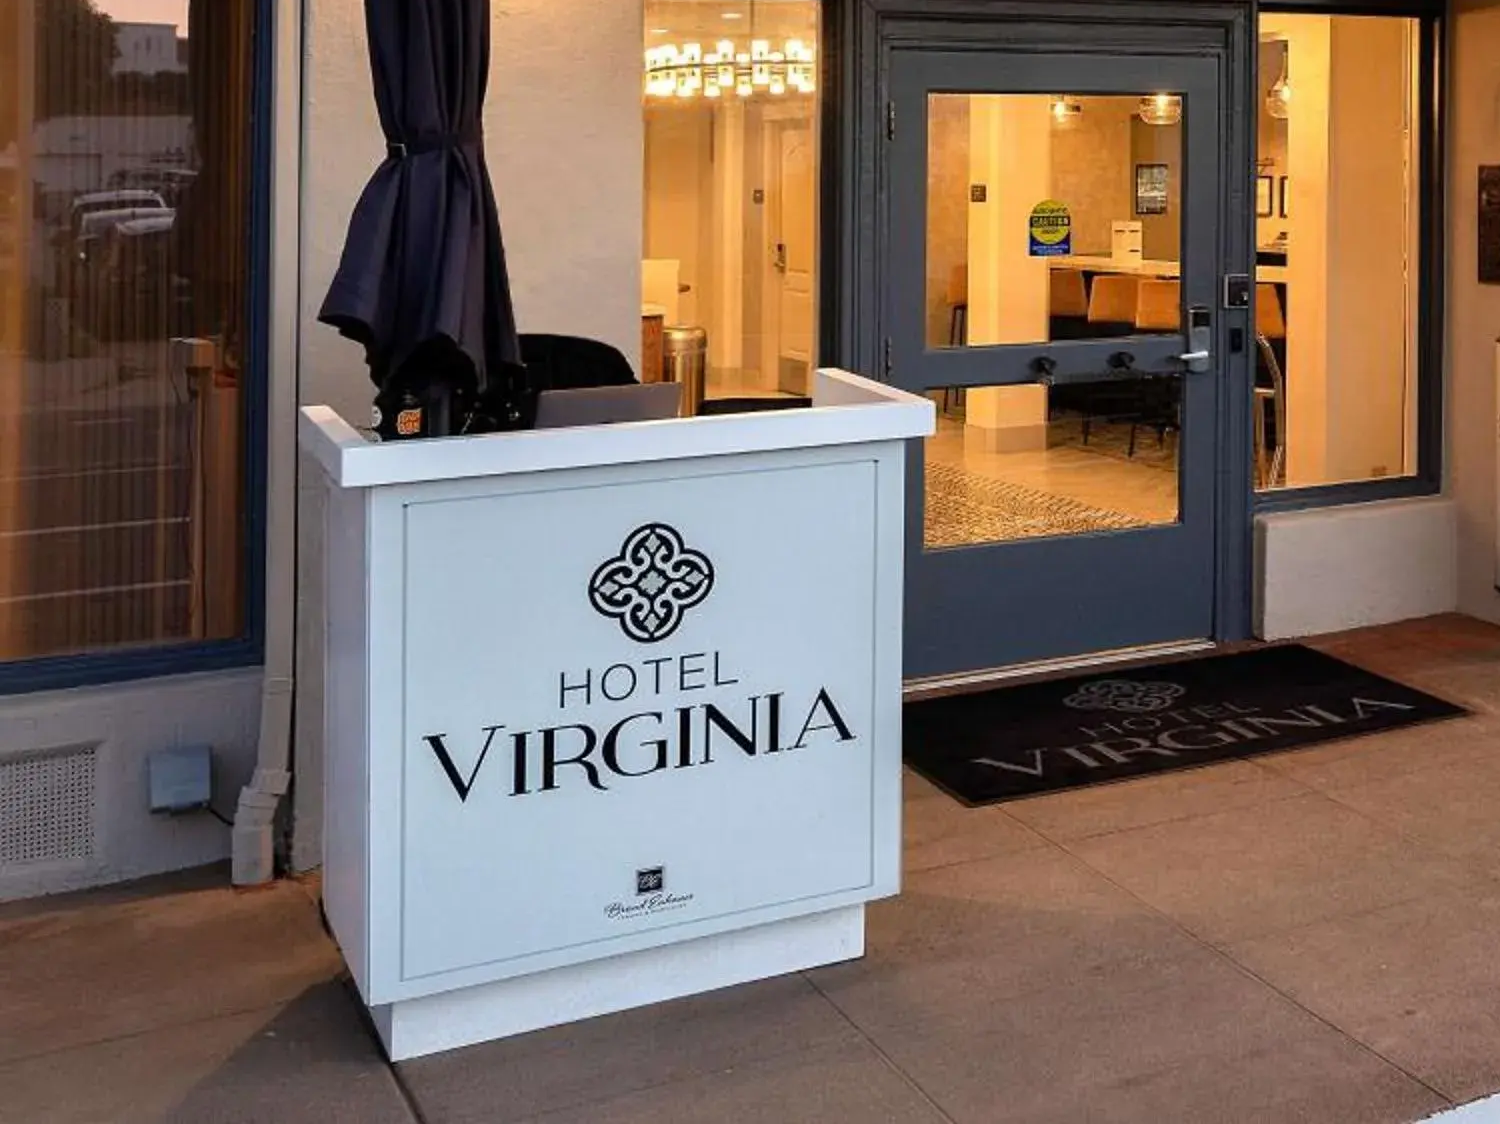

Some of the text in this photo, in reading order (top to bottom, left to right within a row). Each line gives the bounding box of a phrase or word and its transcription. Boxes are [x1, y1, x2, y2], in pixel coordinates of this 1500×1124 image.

[559, 651, 739, 709] HOTEL
[422, 687, 857, 804] VIRGINIA
[973, 696, 1415, 776] VIRGINIA
[1078, 701, 1260, 738] HOTEL
